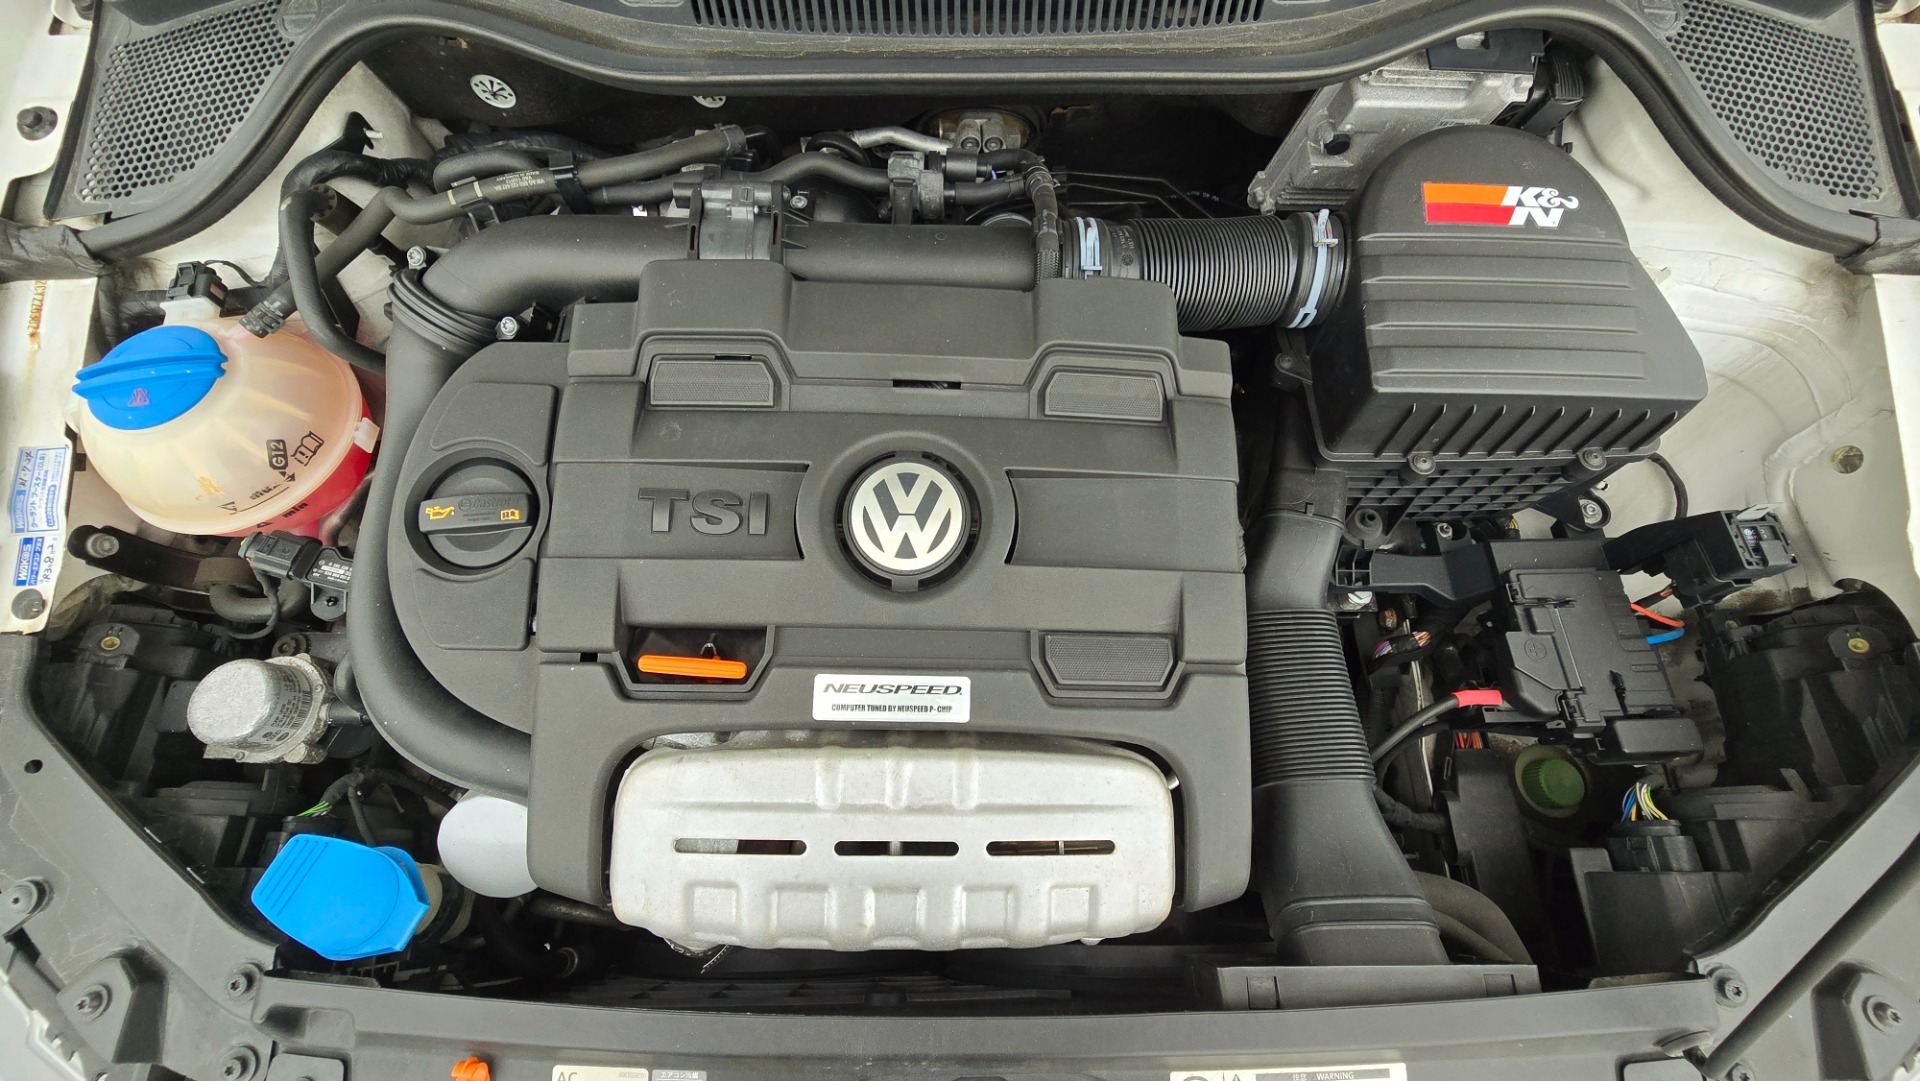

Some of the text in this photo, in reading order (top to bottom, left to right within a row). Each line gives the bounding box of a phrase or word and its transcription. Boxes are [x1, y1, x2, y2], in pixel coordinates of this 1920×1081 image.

[271, 441, 287, 467] G12
[638, 487, 771, 536] TSI
[831, 703, 866, 712] COMPUTER
[867, 704, 887, 713] TUNED
[888, 704, 897, 713] BY
[897, 705, 929, 713] NEUSPEED
[1316, 1071, 1355, 1081] WARNING
